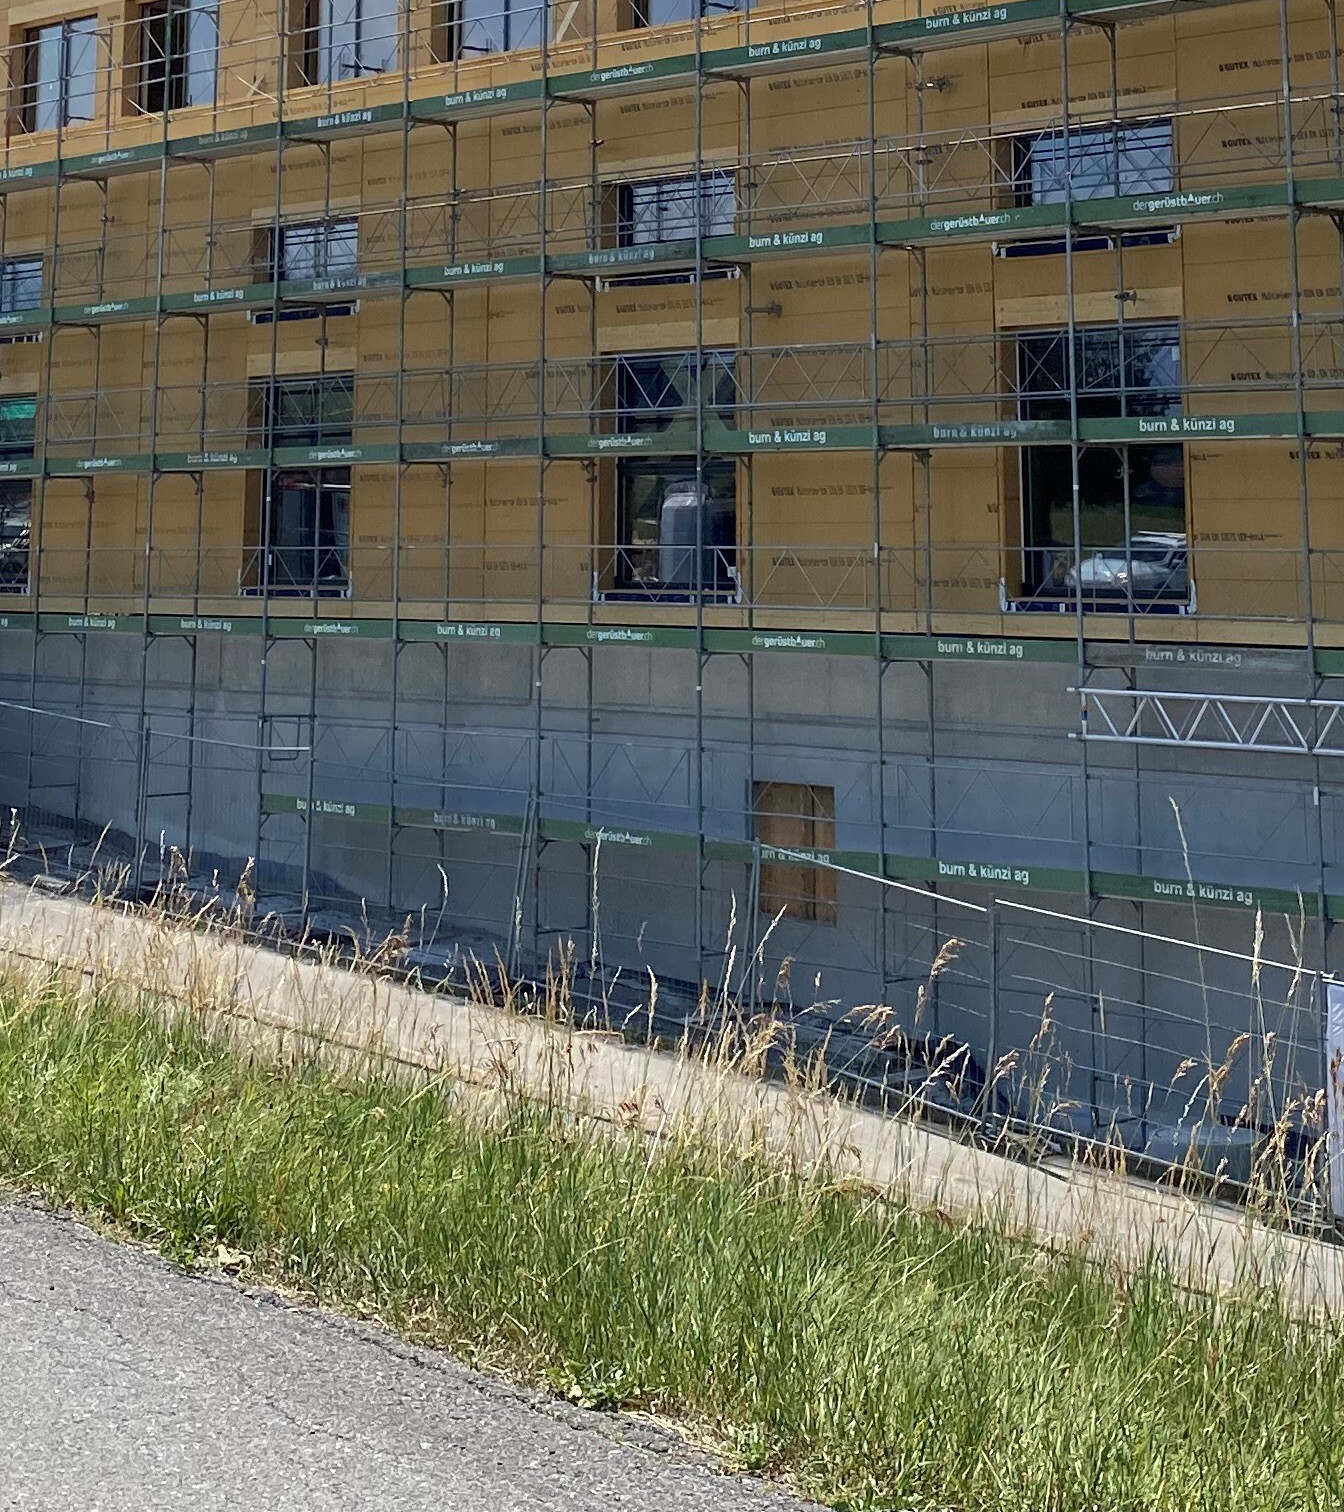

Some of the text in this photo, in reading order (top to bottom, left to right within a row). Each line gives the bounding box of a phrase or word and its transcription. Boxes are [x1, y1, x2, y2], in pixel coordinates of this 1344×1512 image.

[926, 18, 949, 30] burn
[952, 13, 960, 25] &
[994, 8, 1007, 20] ag
[748, 43, 770, 57] burn
[772, 42, 780, 54] &
[809, 38, 821, 50] ag
[1225, 61, 1249, 72] GUTEX
[749, 236, 771, 248] burn
[773, 234, 781, 246] &
[810, 232, 823, 244] ag
[1138, 419, 1167, 431] burn
[1170, 418, 1180, 431] &
[1219, 419, 1235, 432] ag
[748, 432, 771, 444] burn
[774, 430, 782, 443] &
[813, 431, 826, 444] ag
[937, 640, 963, 653] burn
[966, 640, 974, 654] &
[1009, 644, 1023, 658] ag
[938, 860, 966, 876] burn
[968, 864, 977, 877] &
[1014, 870, 1029, 885] ag
[1154, 880, 1182, 896] burn
[1186, 882, 1196, 897] &
[1236, 891, 1253, 906] ag
